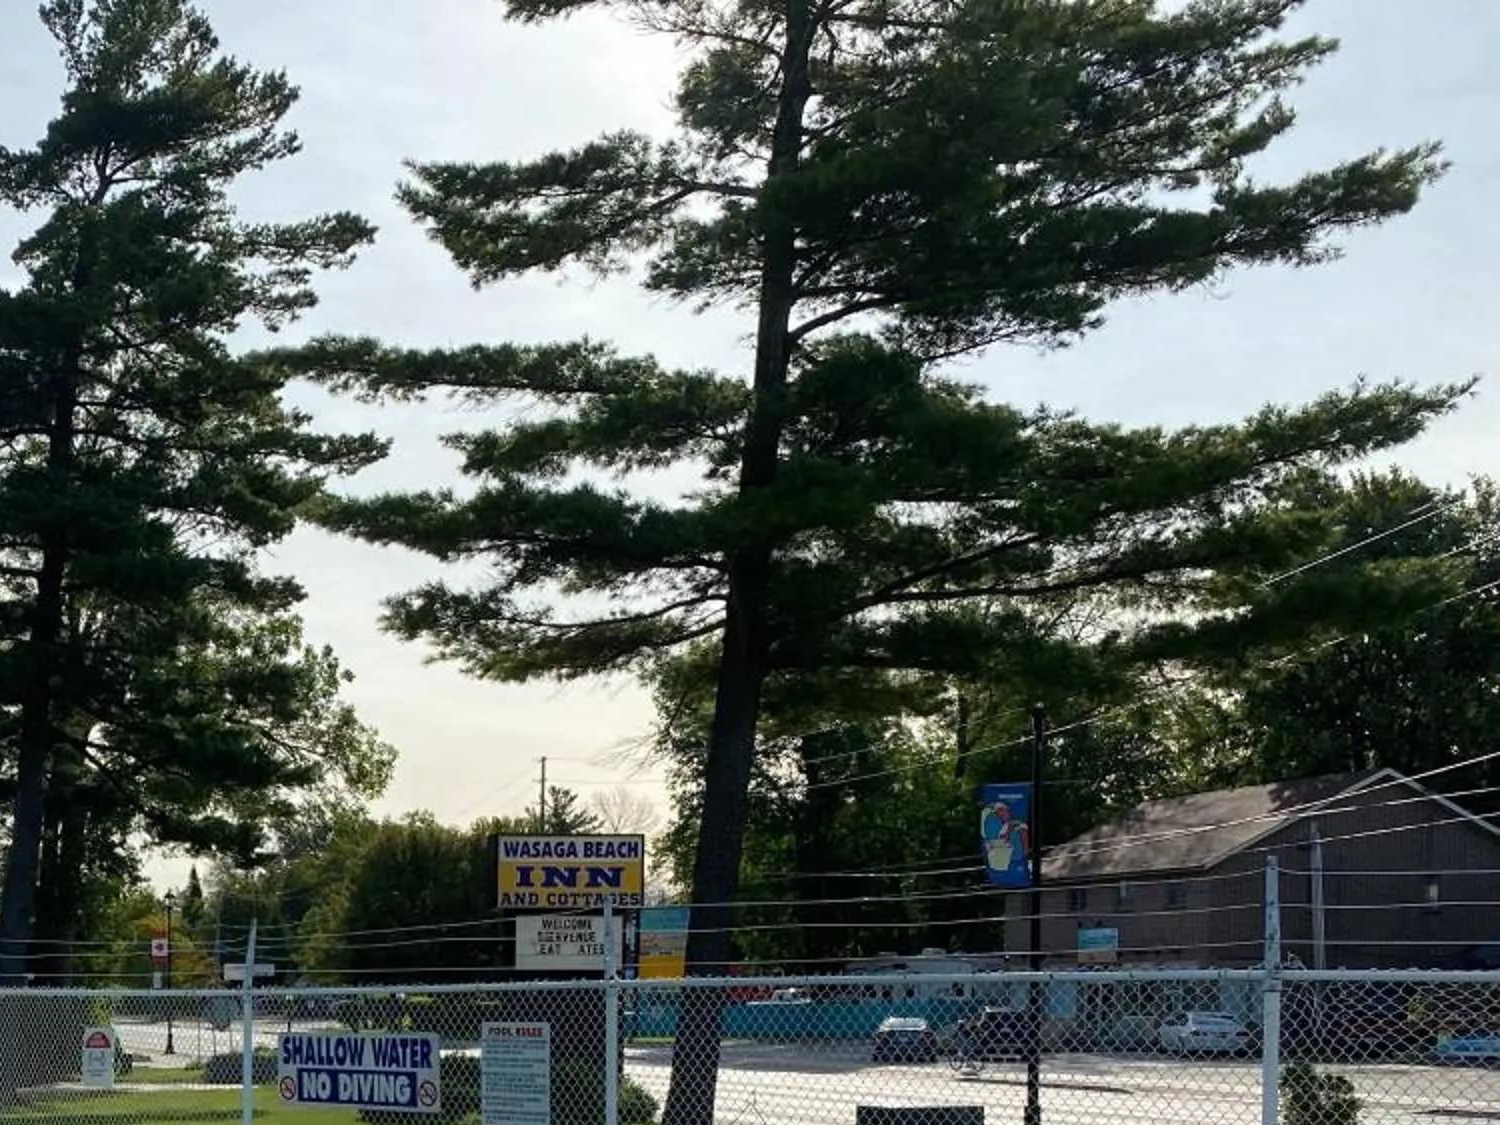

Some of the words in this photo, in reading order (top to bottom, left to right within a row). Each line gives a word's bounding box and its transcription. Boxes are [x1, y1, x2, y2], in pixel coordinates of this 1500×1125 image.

[503, 841, 578, 858] WASAGA
[583, 841, 639, 858] BEACH
[516, 866, 625, 887] INN
[501, 892, 539, 906] AND
[283, 1036, 365, 1066] SHALLOW
[371, 1038, 432, 1068] WATER
[301, 1071, 331, 1099] NO
[338, 1073, 411, 1104] DIVING
